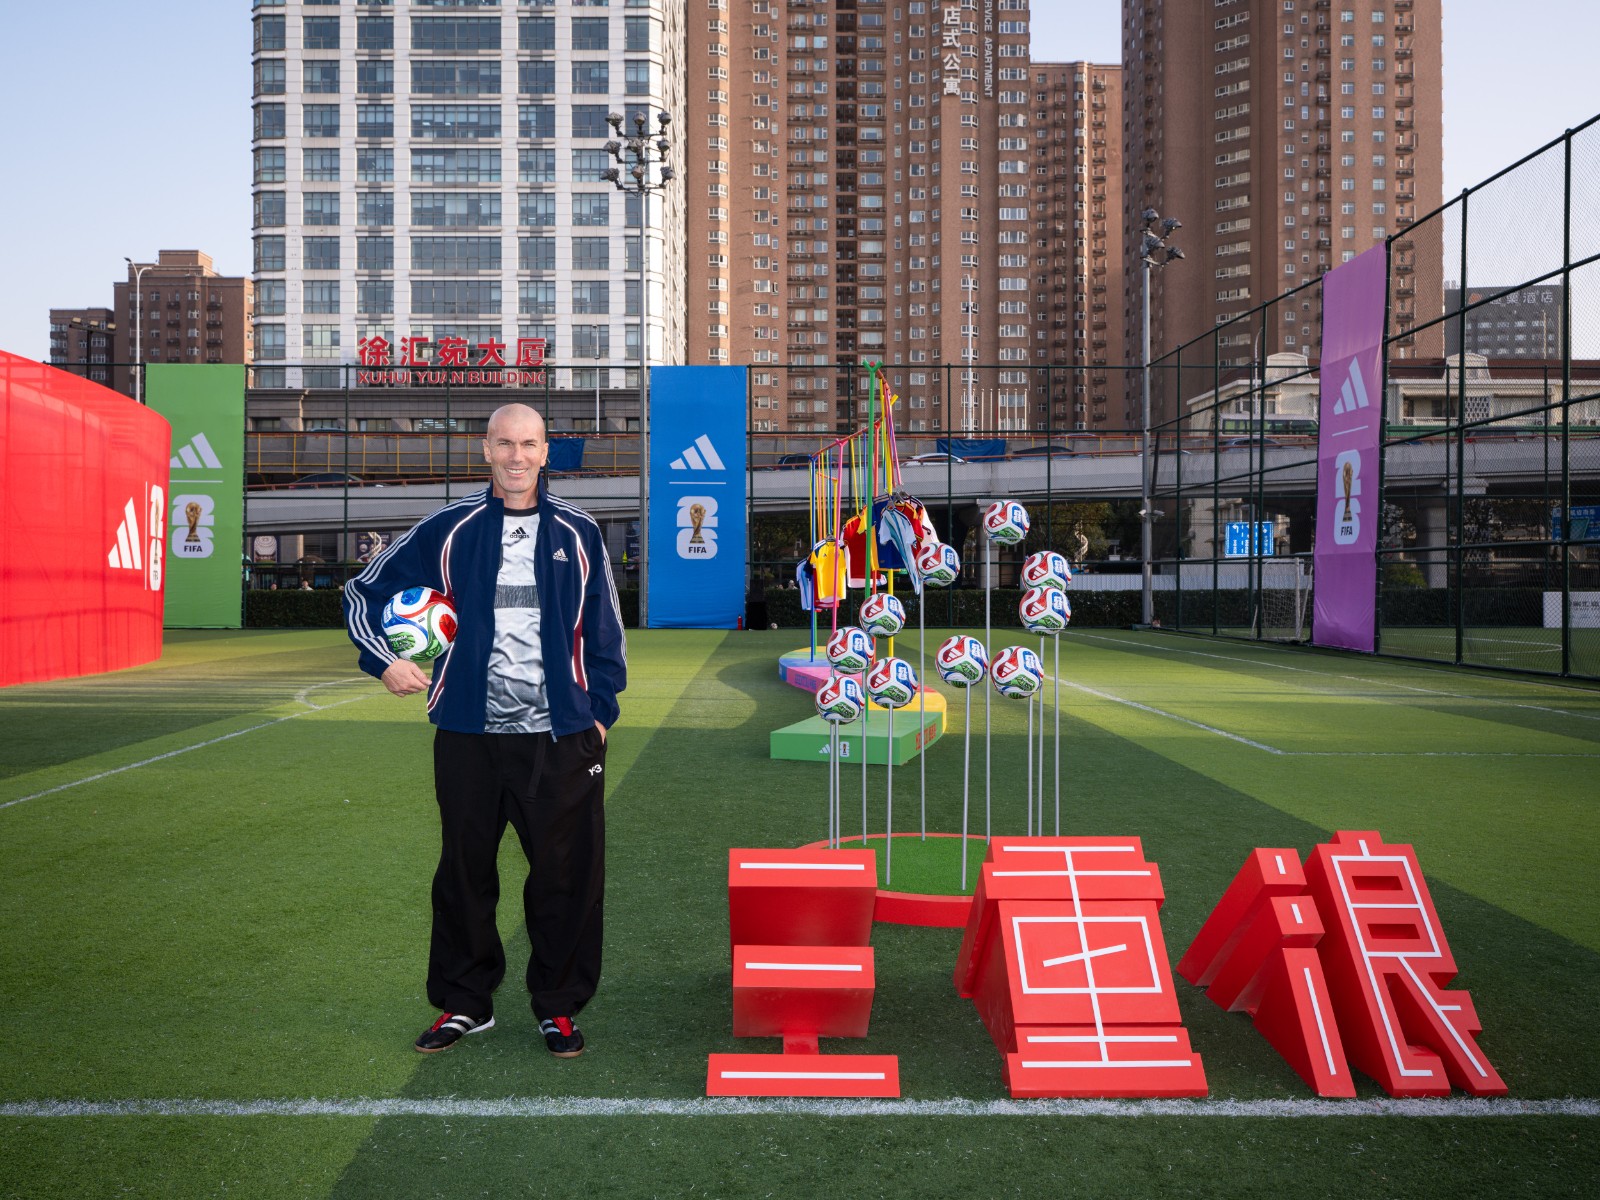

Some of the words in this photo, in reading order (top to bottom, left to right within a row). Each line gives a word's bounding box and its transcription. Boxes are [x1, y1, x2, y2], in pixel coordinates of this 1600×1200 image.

[943, 6, 961, 96] 店式公寓
[985, 37, 993, 97] APARTMENT
[358, 336, 547, 367] 徐汇苑大厦
[358, 371, 412, 384] XUHUI
[416, 371, 464, 384] YUAN
[467, 371, 547, 385] BUILDING
[1340, 526, 1353, 536] FIFA
[183, 545, 203, 553] FIFA
[688, 546, 707, 554] FIFA
